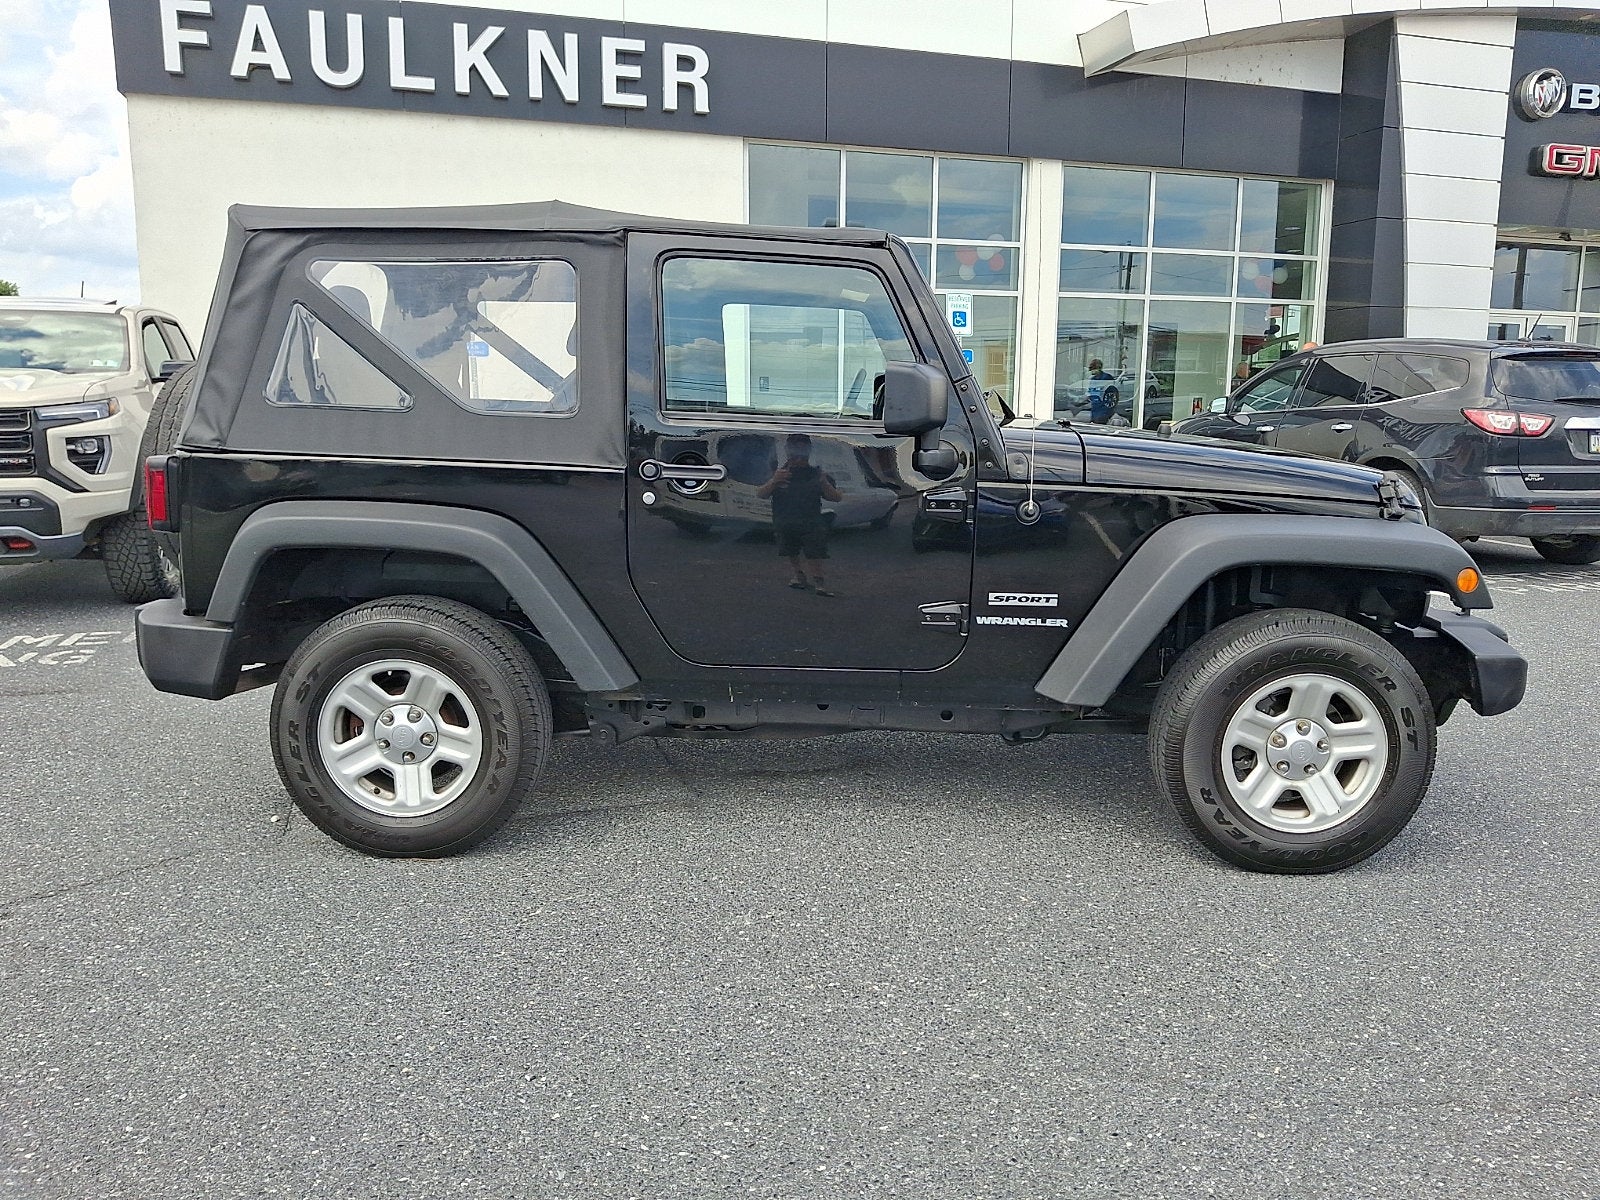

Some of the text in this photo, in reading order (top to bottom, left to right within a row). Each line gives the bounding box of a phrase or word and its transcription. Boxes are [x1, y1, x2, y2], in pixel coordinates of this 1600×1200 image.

[160, 0, 711, 115] FAULKNER
[976, 616, 1068, 628] WRANGLER
[990, 595, 1057, 604] SPORT
[1217, 646, 1419, 752] WRANGLER ST
